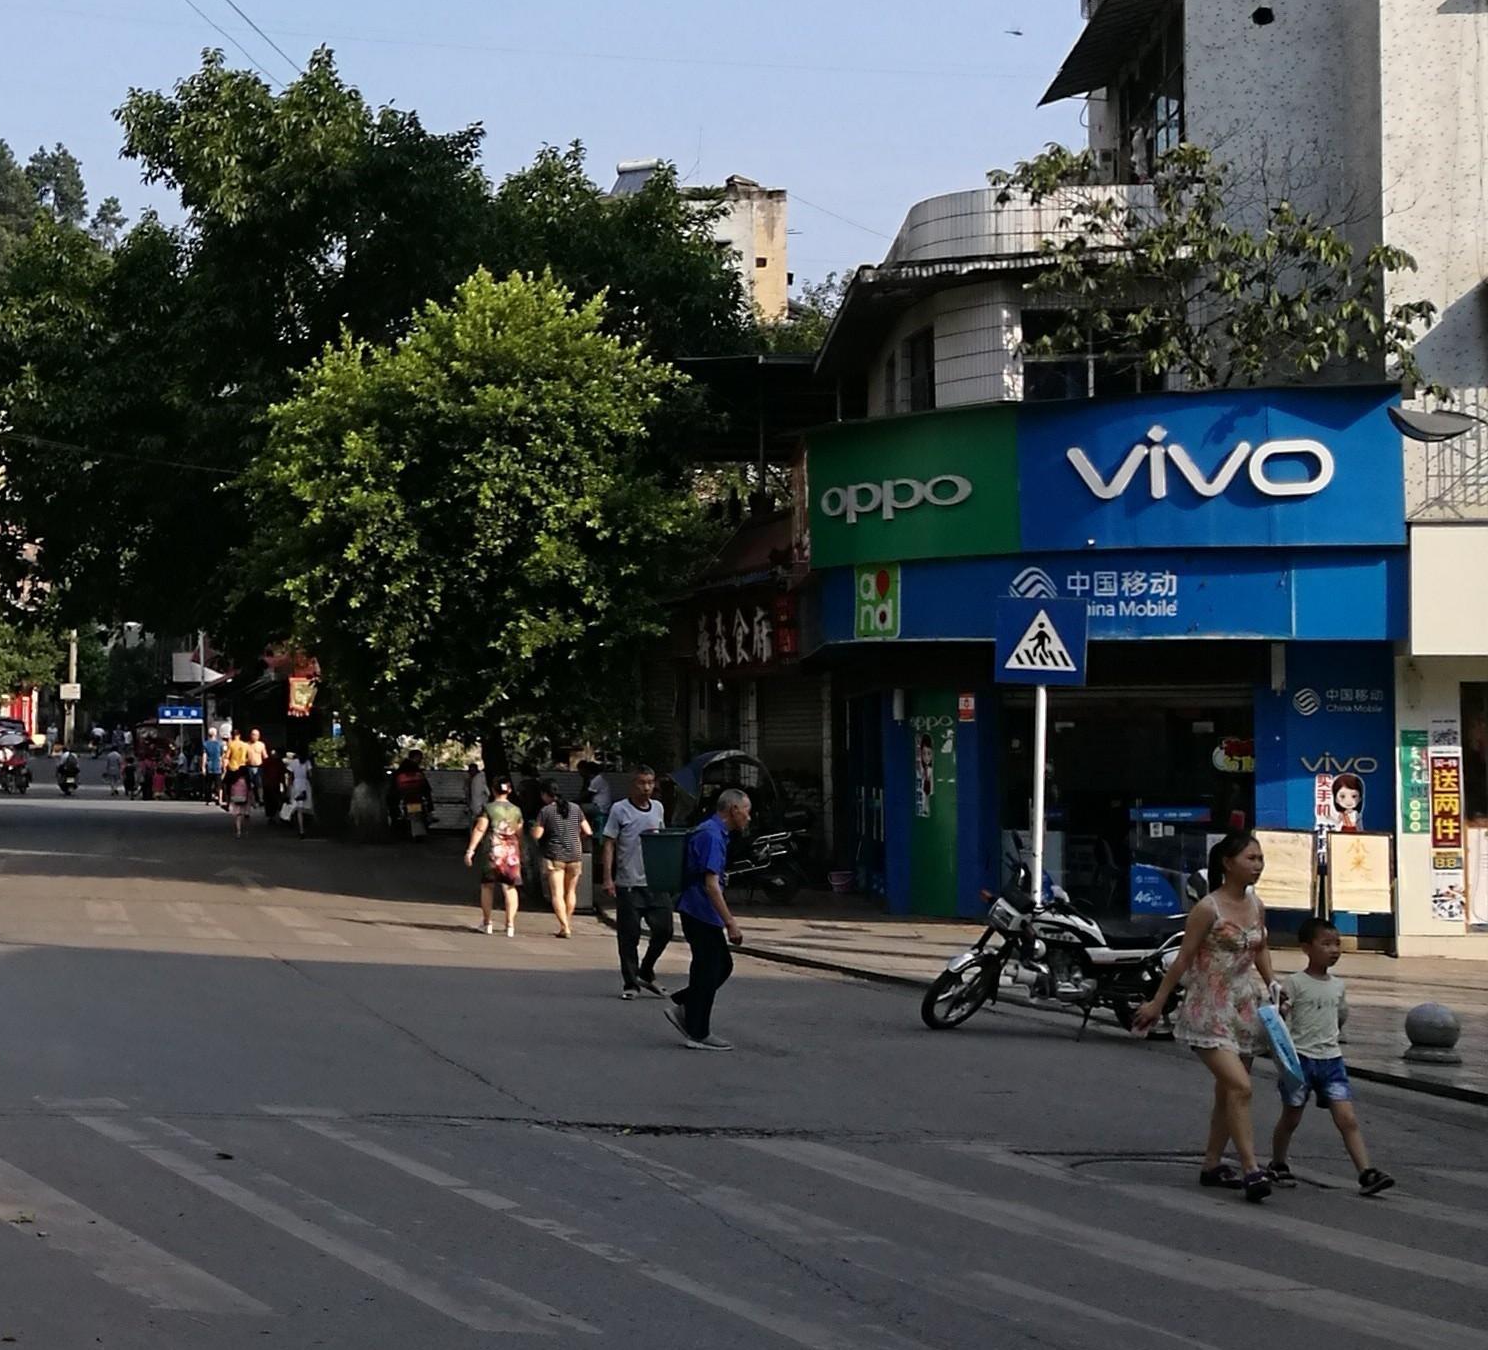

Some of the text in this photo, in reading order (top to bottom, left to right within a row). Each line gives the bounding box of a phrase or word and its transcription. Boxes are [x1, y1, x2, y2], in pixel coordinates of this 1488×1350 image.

[1066, 570, 1178, 597] 中国移动
[1119, 599, 1177, 617] Mobile
[1325, 688, 1385, 703] 中国移动
[1325, 704, 1383, 713] China Mobile
[1316, 774, 1332, 817] 买手机
[1433, 769, 1461, 841] 送两件
[1134, 890, 1151, 904] 4G
